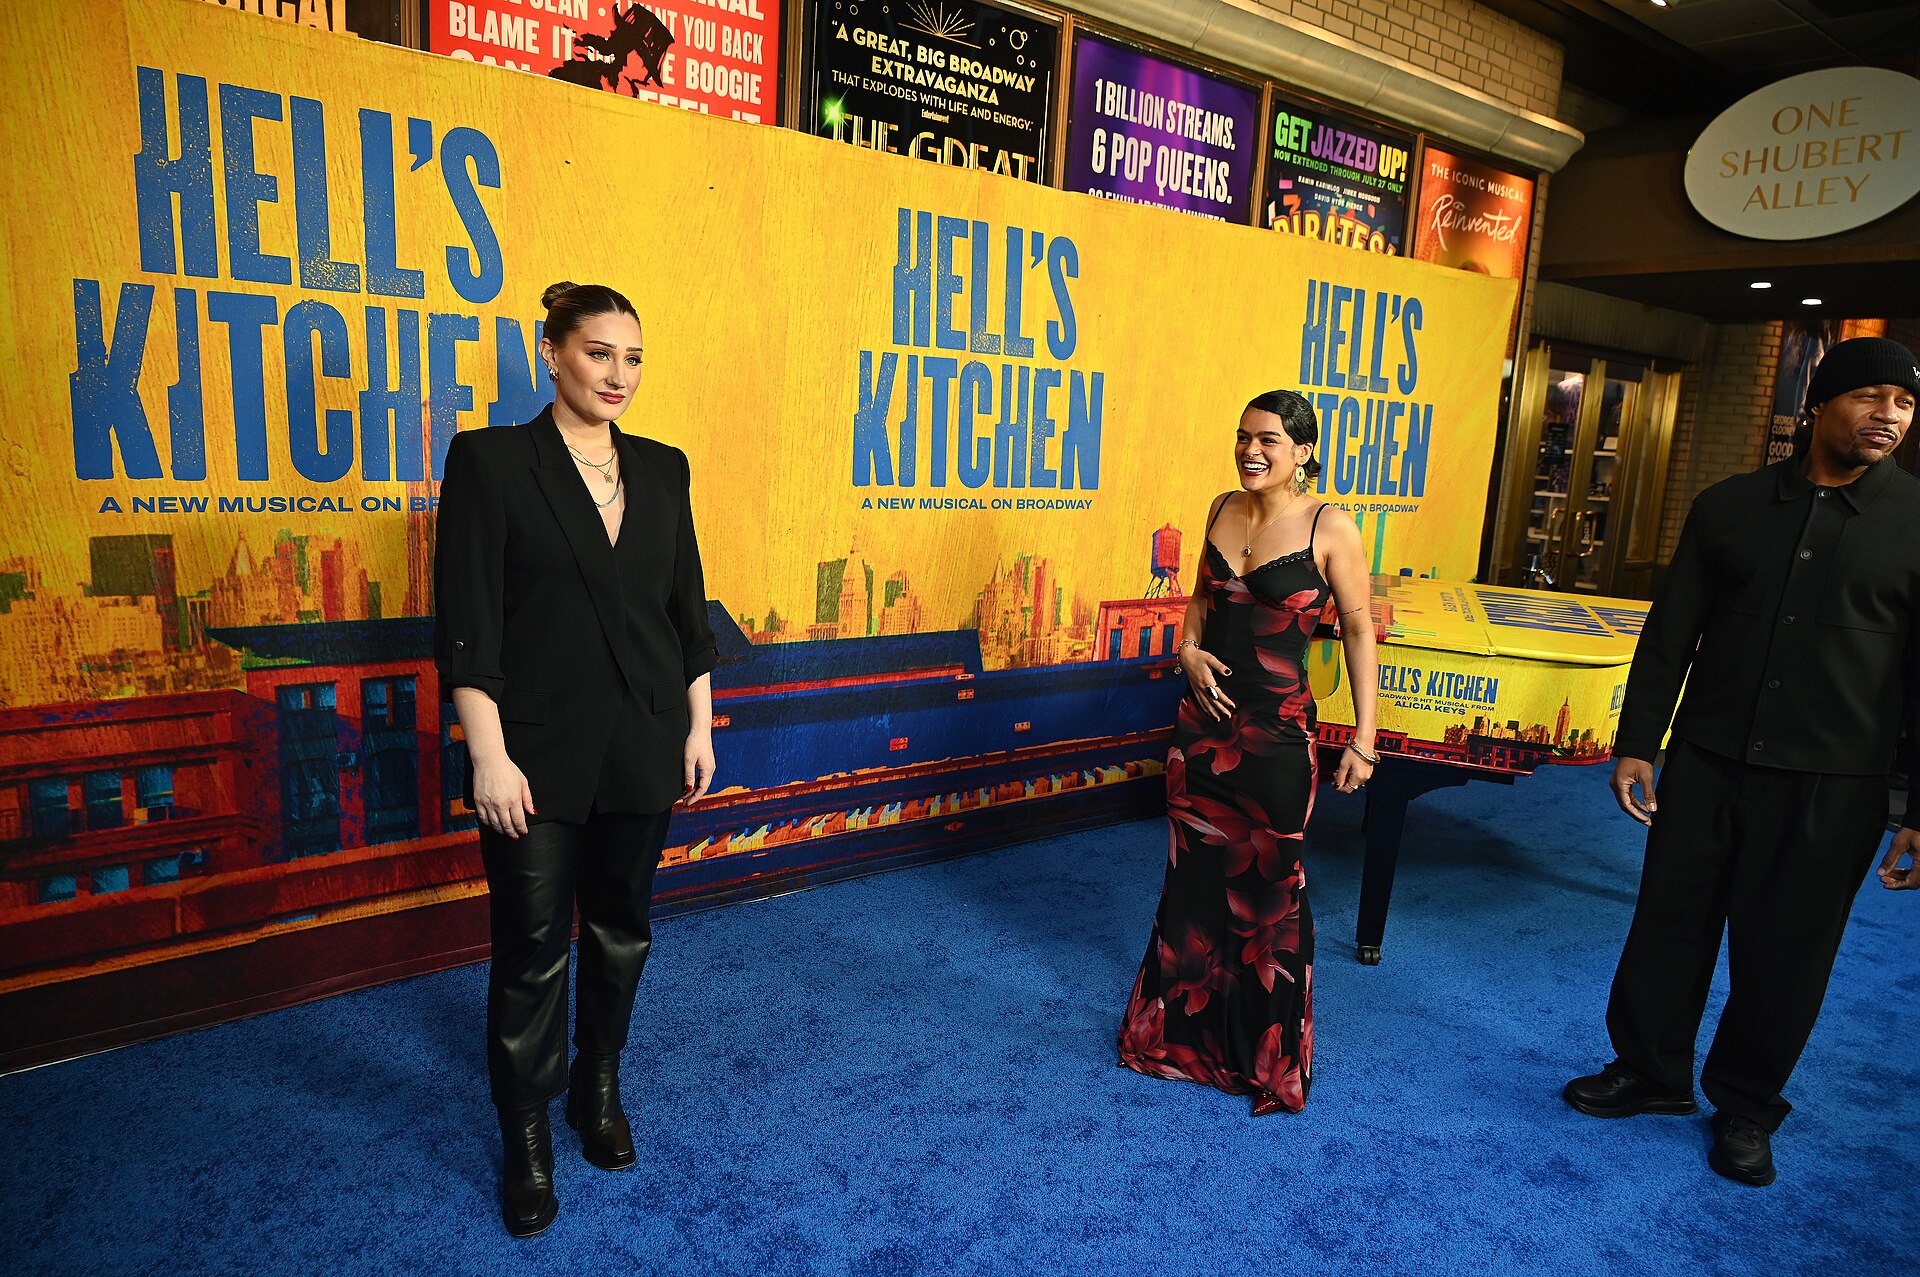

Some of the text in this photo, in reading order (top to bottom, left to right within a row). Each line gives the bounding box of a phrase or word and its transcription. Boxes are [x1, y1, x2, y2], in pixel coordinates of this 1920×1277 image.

[450, 2, 540, 55] BLAME
[552, 25, 576, 61] IT
[683, 14, 716, 53] YOU
[722, 25, 764, 66] BACK
[686, 58, 762, 105] BOOGIE
[853, 28, 912, 62] GREAT,
[917, 45, 945, 68] BIG
[950, 55, 1035, 93] BROADWAY
[872, 56, 999, 105] EXTRAVAGANZA
[832, 69, 860, 87] THAT
[863, 78, 917, 102] EXPLODES
[920, 92, 946, 109] WITH
[949, 100, 968, 115] LIFE
[970, 106, 991, 121] AND
[1095, 78, 1236, 151] 1 BILLION STREAMS.
[1772, 97, 1863, 135] ONE
[1091, 128, 1106, 174] 6
[1110, 132, 1152, 183] POP
[1155, 145, 1233, 205] QUEENS.
[1274, 148, 1403, 194] NOW EXTENDED THROUGH JULY 27 ONLY
[1275, 111, 1408, 182] GET JAZZED UP!
[1719, 130, 1913, 179] SHUBERT
[134, 66, 504, 303] HELL'S
[1431, 163, 1450, 180] THE
[1452, 171, 1485, 190] ICONIC
[1742, 174, 1871, 213] ALLEY
[892, 207, 1079, 361] HELL'S
[1300, 279, 1423, 395] HELL'S
[852, 350, 1104, 490] KITCHEN
[1294, 390, 1434, 497] TCHEN
[1769, 441, 1794, 457] GOOD
[99, 497, 123, 513] A
[132, 497, 209, 513] NEW
[218, 496, 353, 513] MUSICAL
[360, 496, 401, 512] ON
[861, 497, 1093, 510] A NEW MUSICAL ON BROADWAY
[1353, 503, 1367, 512] ON
[1369, 503, 1419, 513] BROADWAY
[1377, 692, 1418, 702] OADWAY'S
[1434, 699, 1470, 709] MUSICAL
[1471, 704, 1495, 712] FROM
[1393, 700, 1466, 716] ALICIA KEYS
[1426, 670, 1499, 705] KITCHEN
